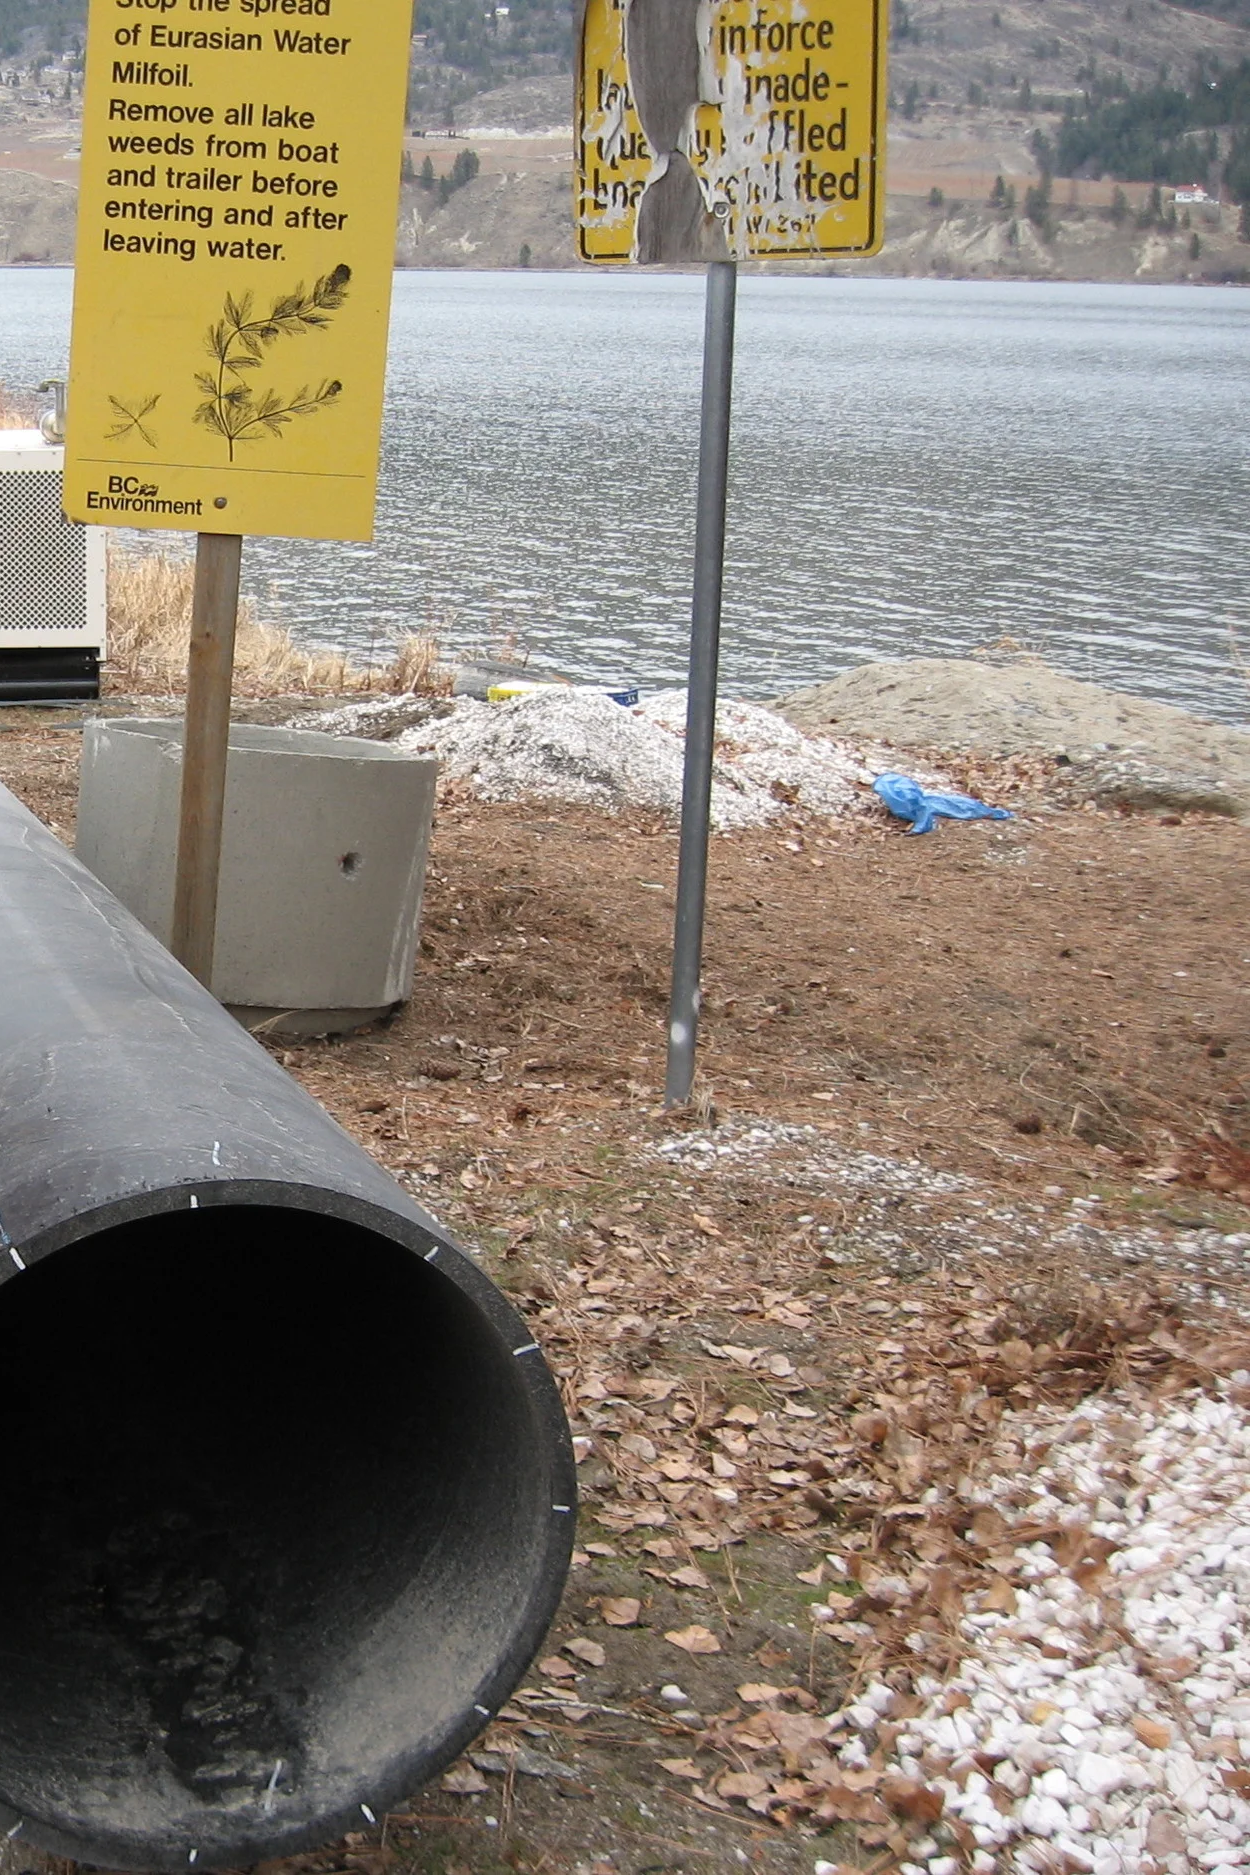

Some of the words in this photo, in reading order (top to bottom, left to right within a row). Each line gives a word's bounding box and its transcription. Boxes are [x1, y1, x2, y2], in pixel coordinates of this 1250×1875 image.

[239, 0, 331, 18] spread
[114, 23, 142, 46] of
[150, 24, 262, 51] Eurasian
[273, 28, 352, 56] Water
[112, 61, 193, 88] Milfoil.
[108, 98, 214, 125] Remove
[224, 102, 254, 127] all
[261, 103, 316, 130] lake
[107, 132, 195, 156] weeds
[205, 133, 267, 160] from
[277, 138, 340, 164] boat
[106, 164, 156, 188] and
[165, 166, 243, 192] trailer
[252, 169, 339, 198] before
[104, 198, 213, 228] entering
[223, 204, 274, 227] and
[284, 205, 349, 231] after
[103, 229, 196, 262] leaving
[206, 237, 286, 261] water.
[108, 475, 140, 495] BC
[86, 490, 203, 516] Environment
